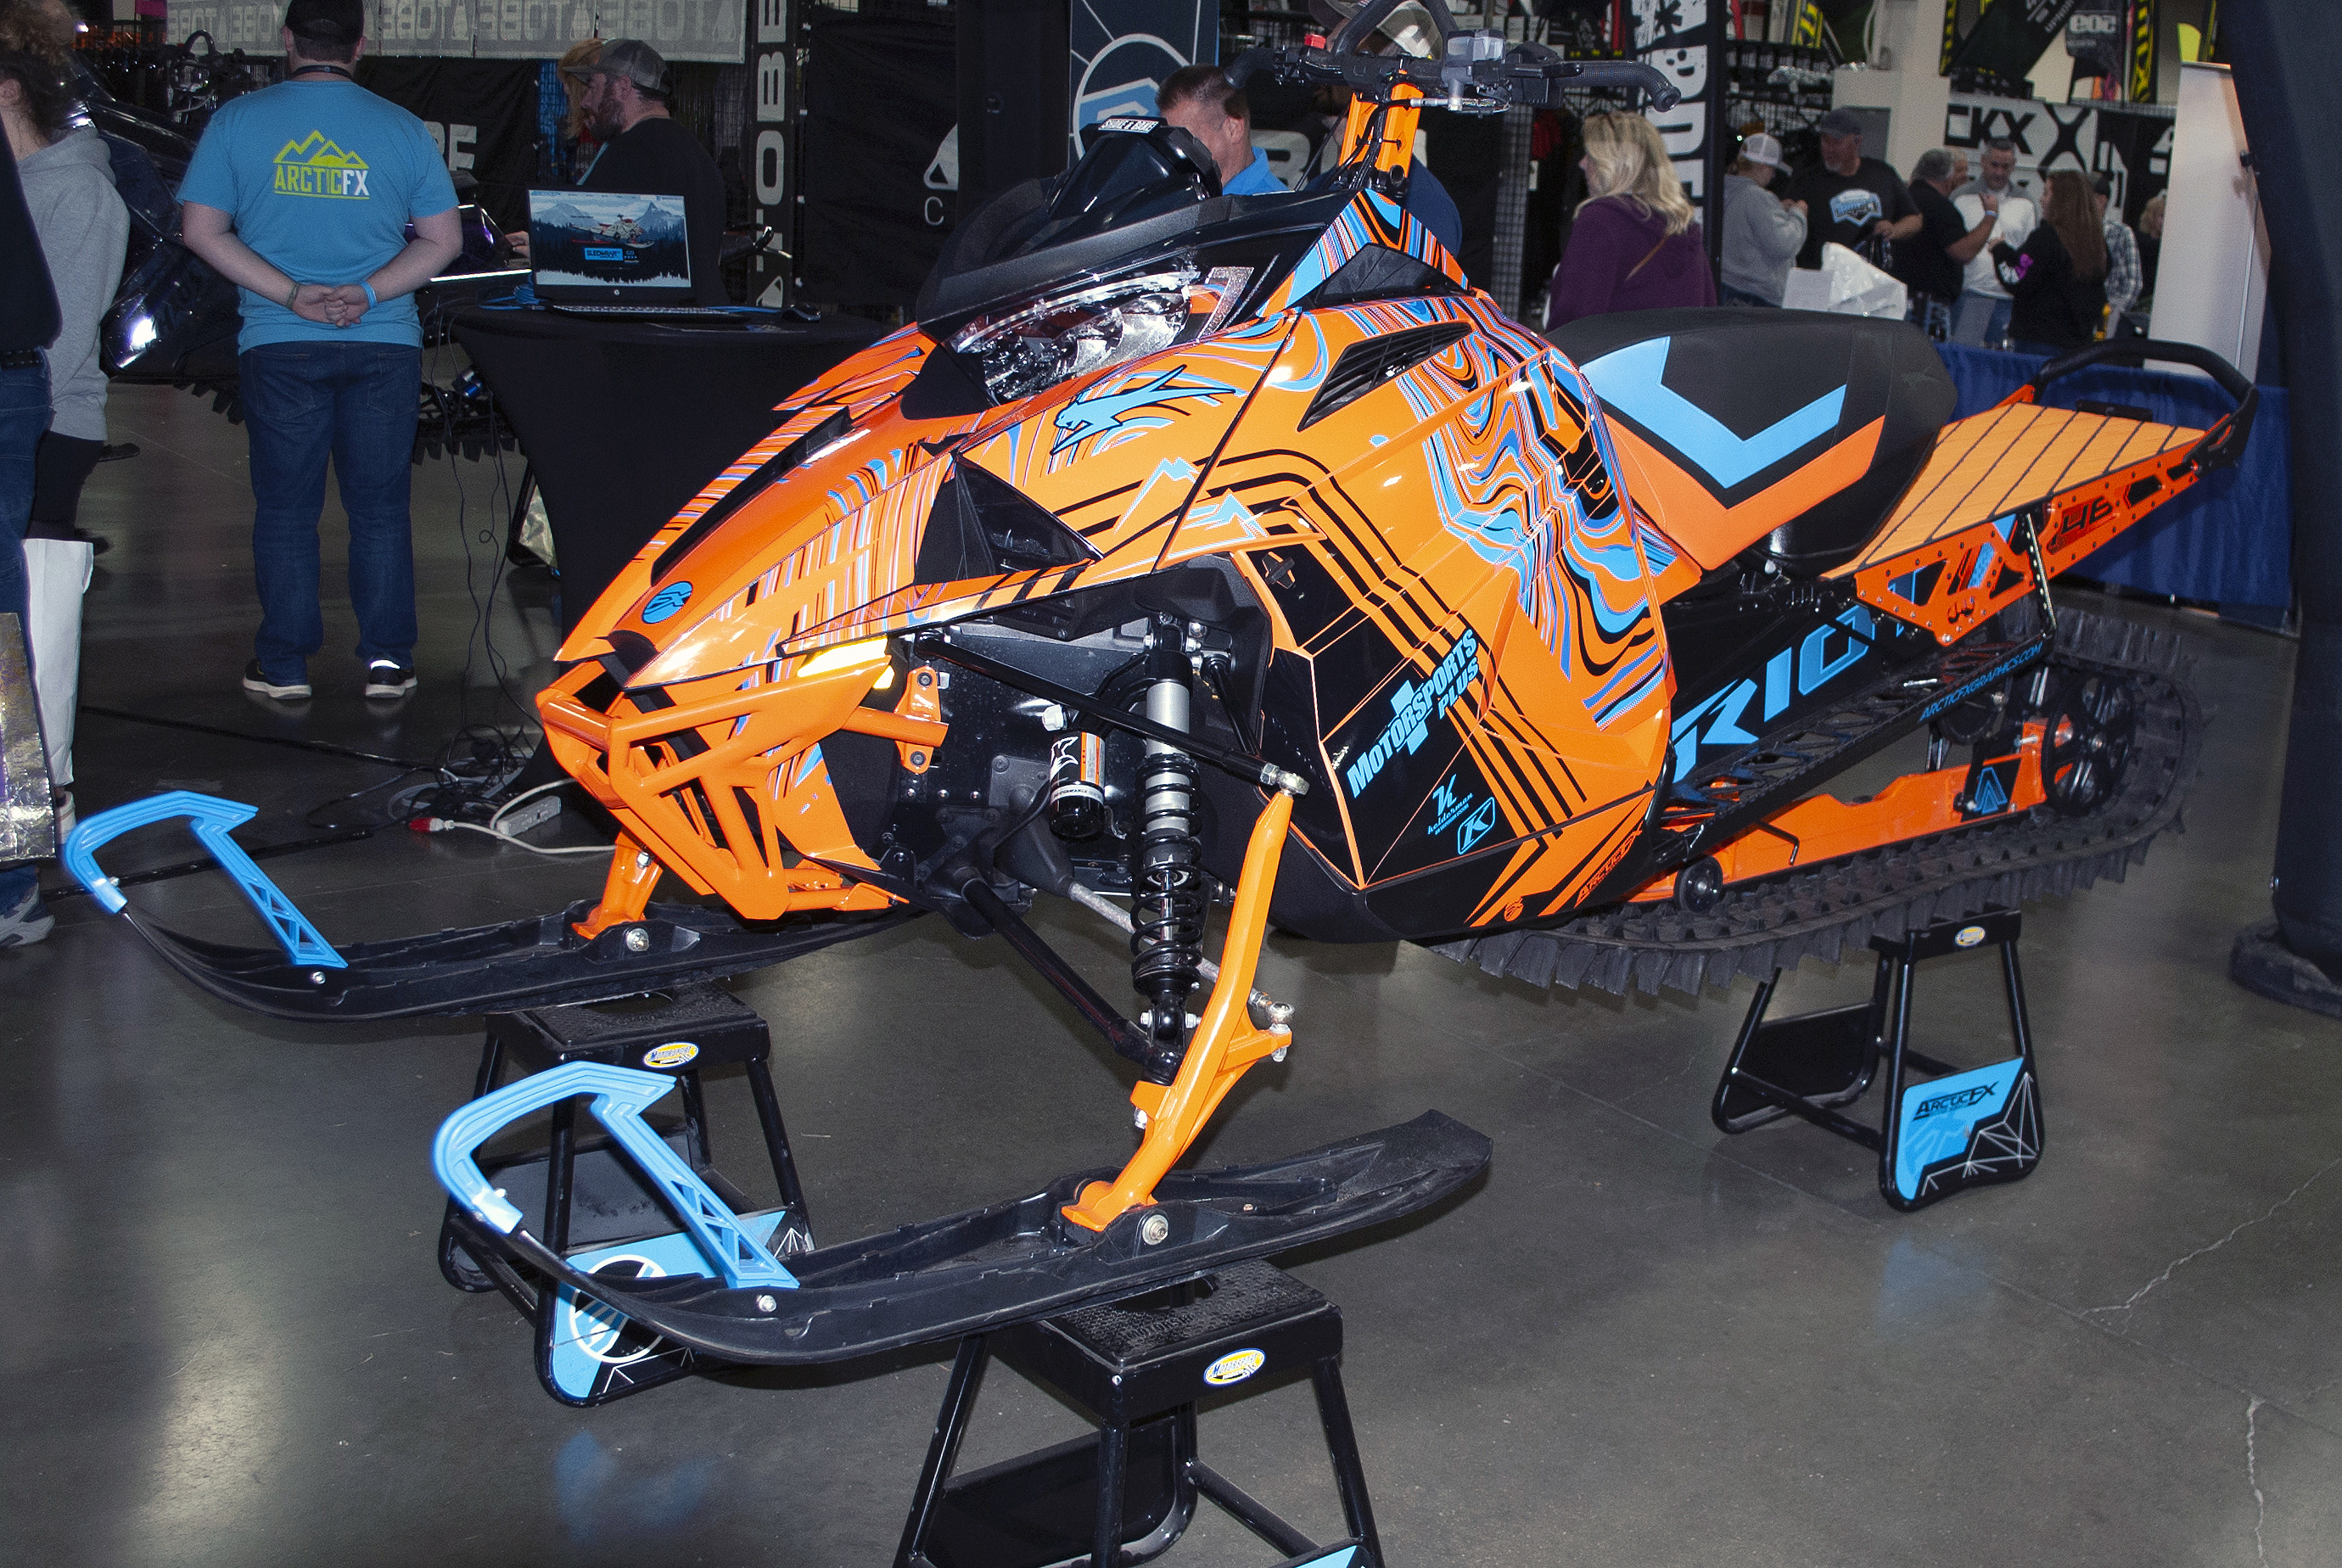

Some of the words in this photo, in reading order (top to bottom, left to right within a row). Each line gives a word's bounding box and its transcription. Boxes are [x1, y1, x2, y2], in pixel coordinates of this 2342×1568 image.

[274, 165, 370, 196] ARCTICFX
[1347, 629, 1476, 798] MOTORSPORTS
[1437, 657, 1479, 720] PLUS
[1671, 604, 1906, 784] RIO
